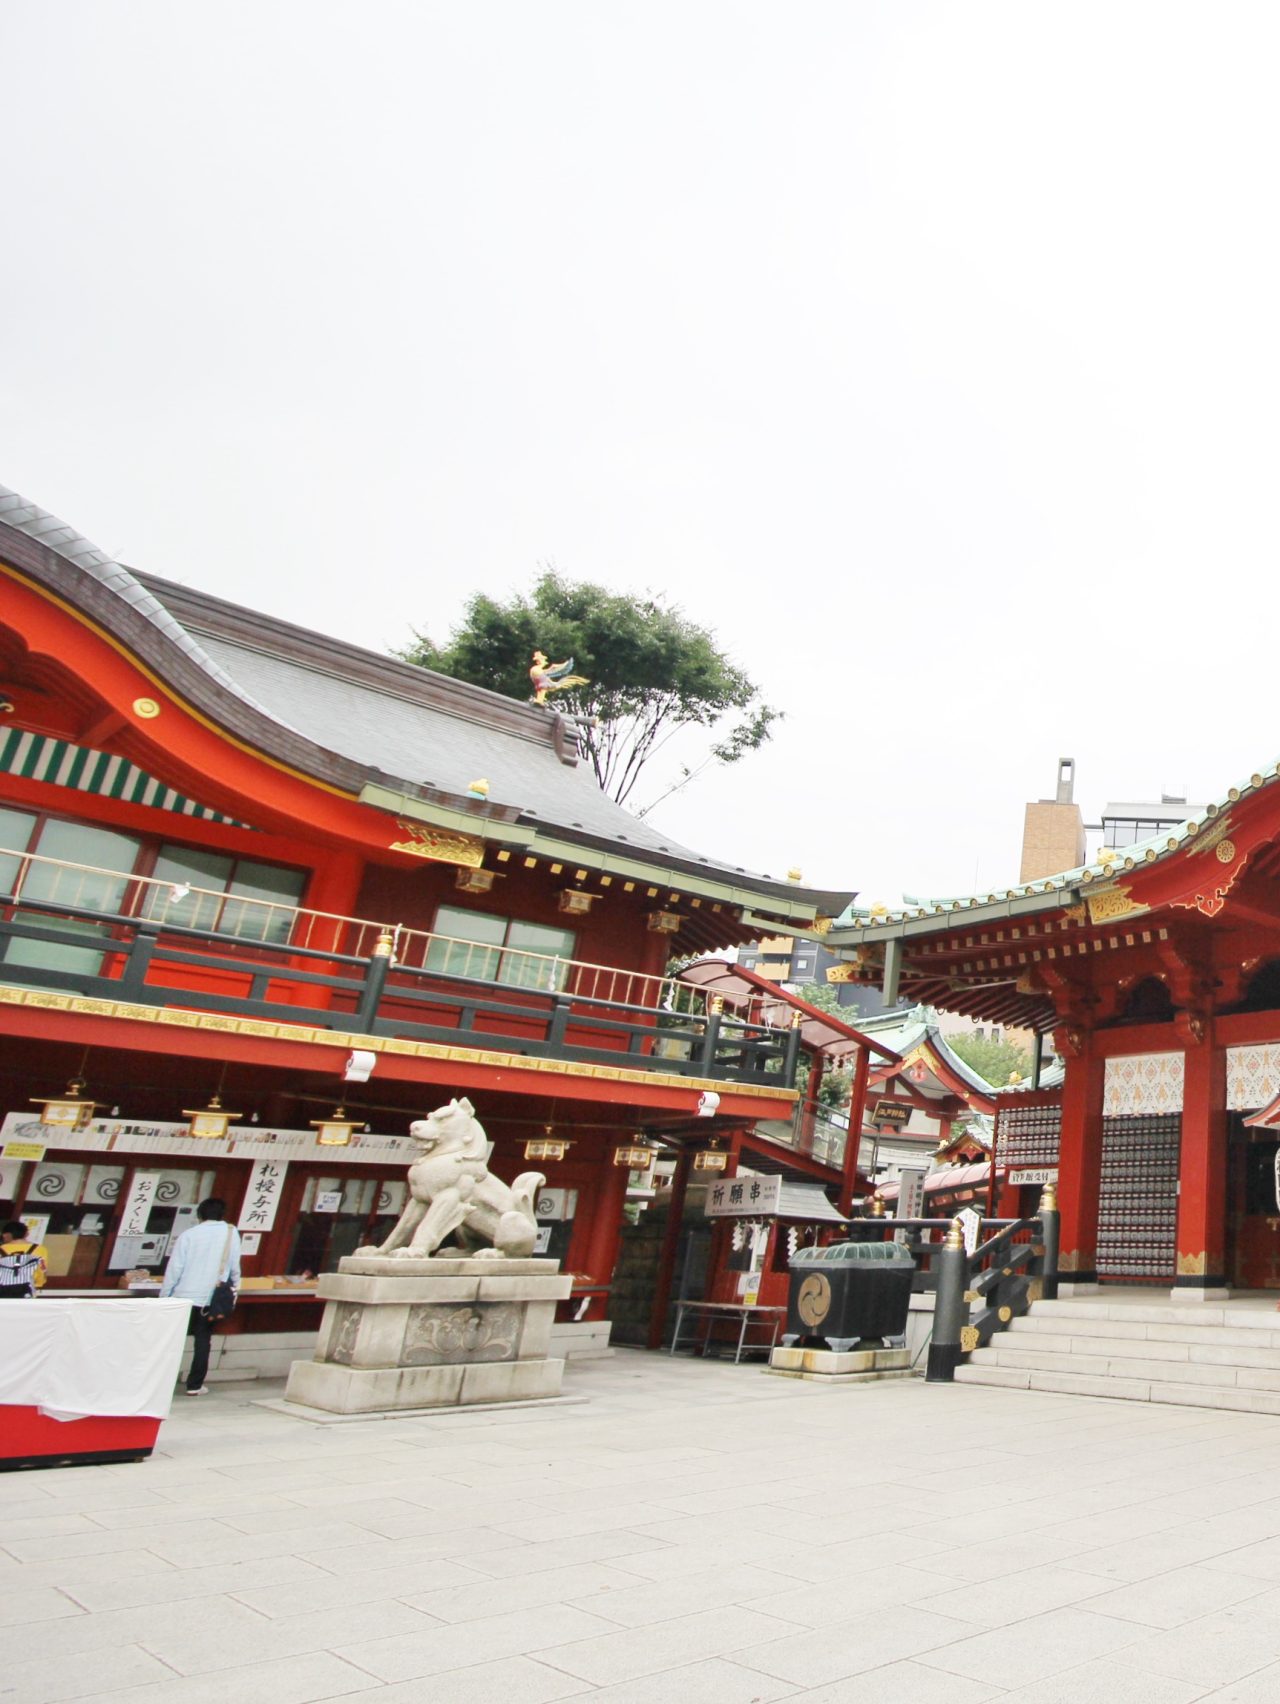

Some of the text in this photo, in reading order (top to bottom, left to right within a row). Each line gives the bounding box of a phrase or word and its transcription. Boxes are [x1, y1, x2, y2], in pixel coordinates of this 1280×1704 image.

[128, 1180, 152, 1230] おみくじ
[245, 1159, 280, 1225] 札授与所
[712, 1181, 761, 1206] 祈願串
